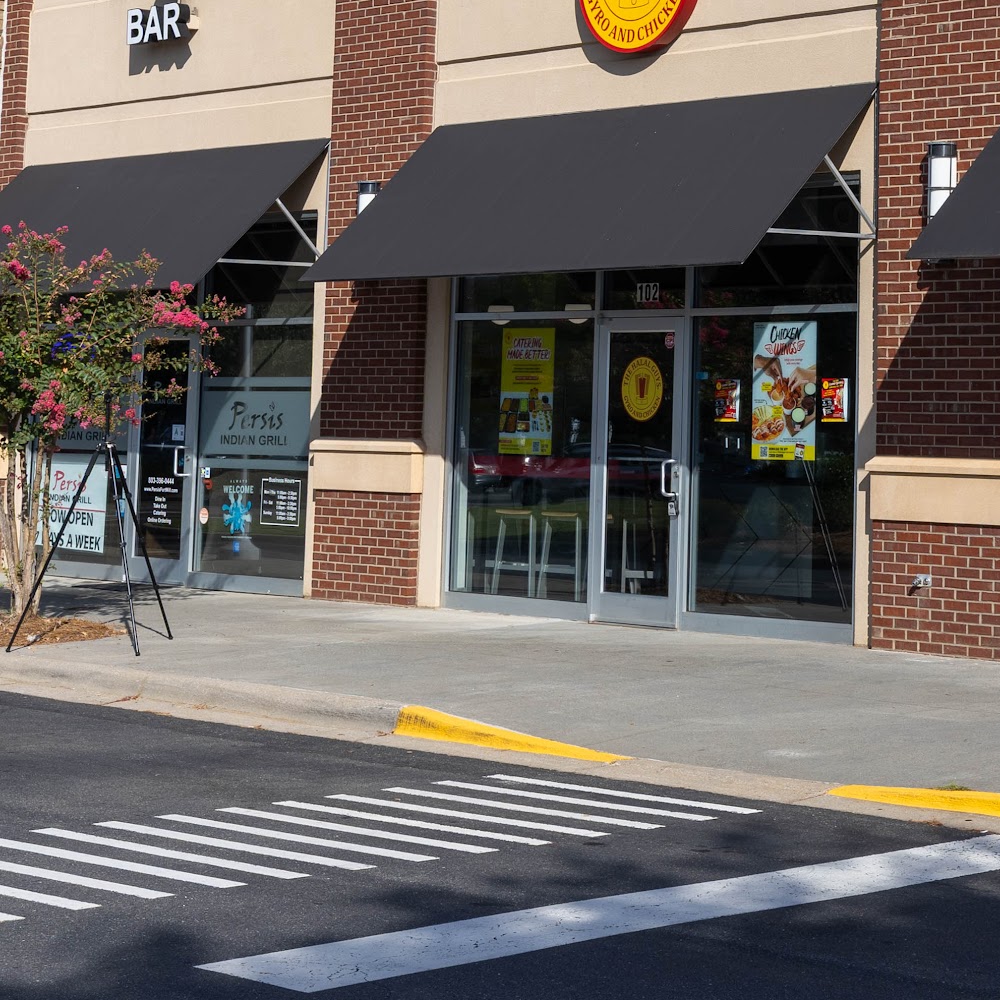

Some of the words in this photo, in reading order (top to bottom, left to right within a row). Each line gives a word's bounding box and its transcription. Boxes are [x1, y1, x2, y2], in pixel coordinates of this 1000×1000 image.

[127, 3, 184, 45] BAR
[608, 26, 635, 44] AND
[638, 283, 658, 301] 102
[513, 337, 543, 348] CATERING
[506, 349, 523, 360] MADE
[623, 367, 633, 387] THE
[631, 358, 651, 371] HALAL
[228, 400, 284, 431] Persis
[623, 395, 633, 413] GYRO
[632, 410, 643, 419] AND
[642, 396, 661, 419] CHICKEN
[220, 434, 256, 446] INDIAN
[258, 435, 288, 446] GRILL
[222, 484, 254, 494] WELCOME
[68, 511, 94, 526] OPEN
[65, 533, 73, 548] A
[75, 534, 101, 551] WEEK
